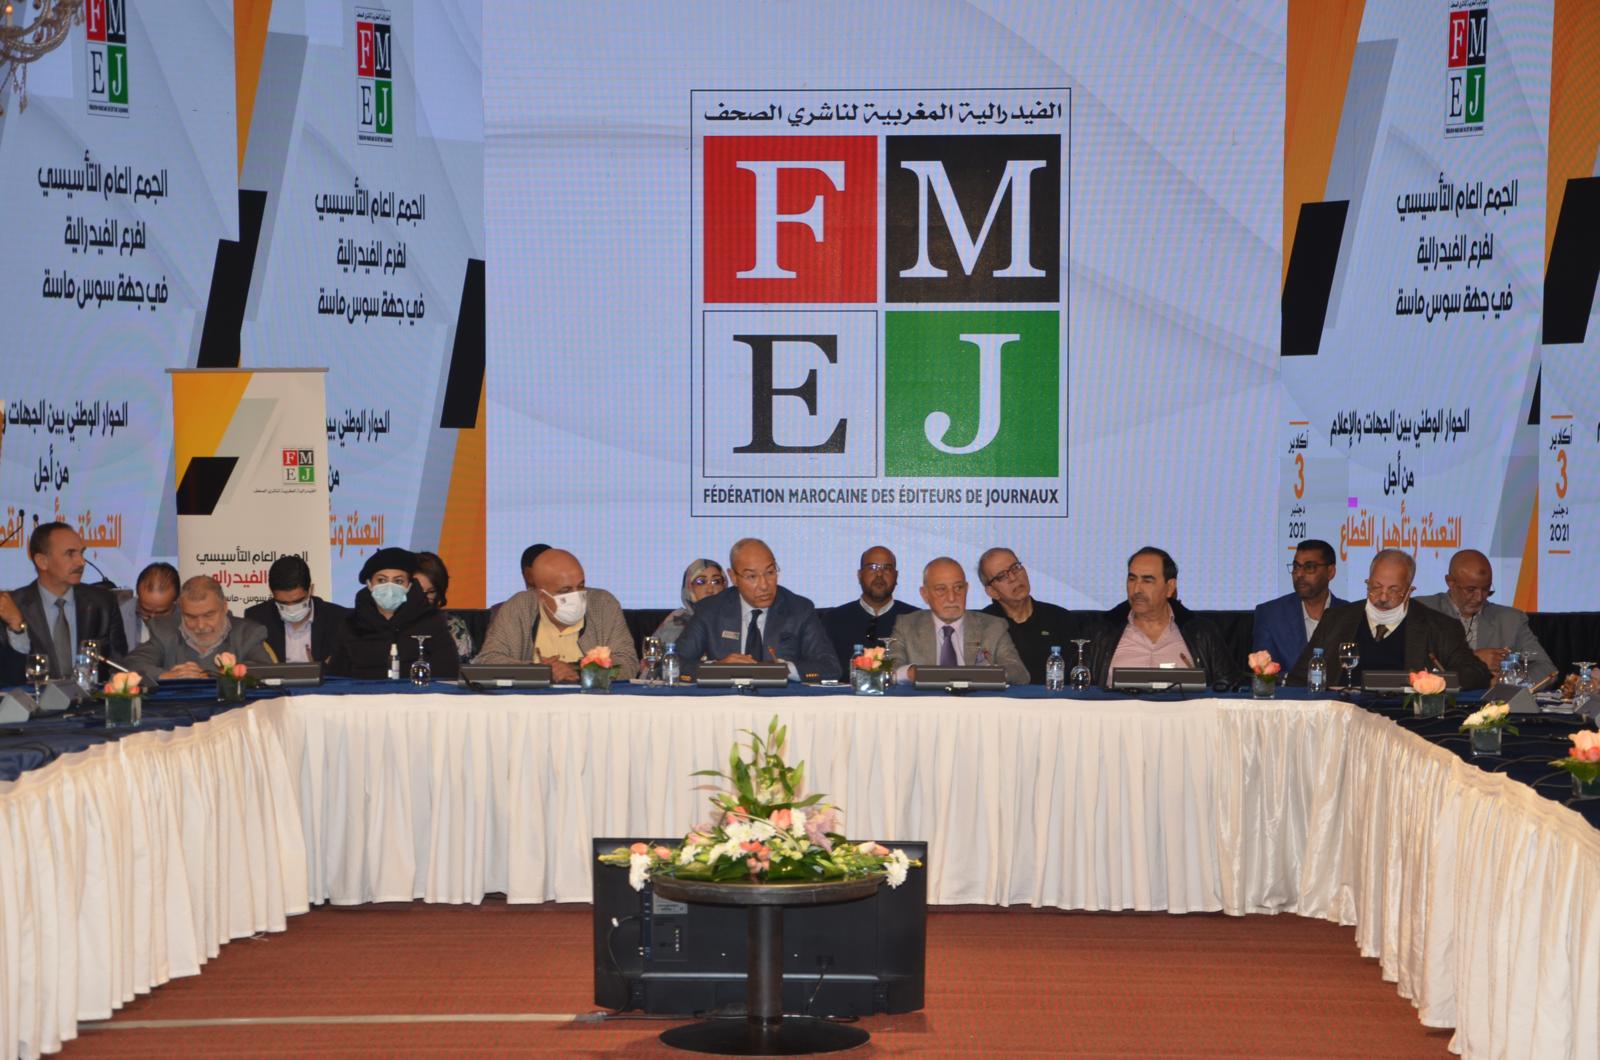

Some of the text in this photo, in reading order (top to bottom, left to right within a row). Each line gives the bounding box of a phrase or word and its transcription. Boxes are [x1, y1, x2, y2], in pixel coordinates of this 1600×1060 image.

[359, 29, 390, 71] F M
[1451, 17, 1486, 60] F M
[90, 51, 123, 96] E J
[360, 85, 389, 127] E J
[704, 100, 1062, 127] الفيدرالية المغربية لناشري الصحف
[1449, 74, 1482, 117] E J
[38, 149, 167, 205] الجمع العام التأسيسي
[1396, 172, 1518, 222] الجمع العام التأسيسي
[315, 176, 425, 227] الجمع العام التأسيسي
[736, 160, 1047, 278] F M
[64, 216, 146, 256] لفرع الفيدرالية
[337, 238, 406, 275] لفرع الفيدرالية
[1417, 232, 1494, 271] لفرع الفيدرالية
[42, 268, 168, 312] في جهة سوس ماسة
[318, 288, 425, 326] في جهة سوس ماسة
[1396, 283, 1513, 323] في جهة سوس ماسة
[733, 333, 1020, 455] E J
[8, 399, 45, 434] الجهات
[47, 403, 65, 434] بين
[67, 399, 100, 442] الوطني
[102, 399, 128, 437] الحوار
[338, 408, 366, 448] الوطني
[367, 408, 390, 443] الحوار
[1330, 407, 1470, 448] الحوار الوطني بين الجهات والإعلام
[34, 443, 69, 492] من أجل
[285, 451, 312, 464] F M
[286, 468, 312, 480] E J
[1294, 452, 1305, 499] 3
[1383, 450, 1414, 496] من أجل
[1556, 449, 1568, 499] 3
[328, 464, 340, 493] من
[703, 485, 1058, 508] FÉDÉRATION MAROCAINE DES ÉDITEURS DE JOURNAUX
[346, 511, 384, 556] التعبئة
[1289, 522, 1307, 538] 2021
[1340, 509, 1375, 561] القطاع
[1420, 511, 1461, 559] التعبئة
[1550, 523, 1570, 542] 2021
[196, 546, 250, 565] التأسيسي
[252, 551, 277, 565] العام
